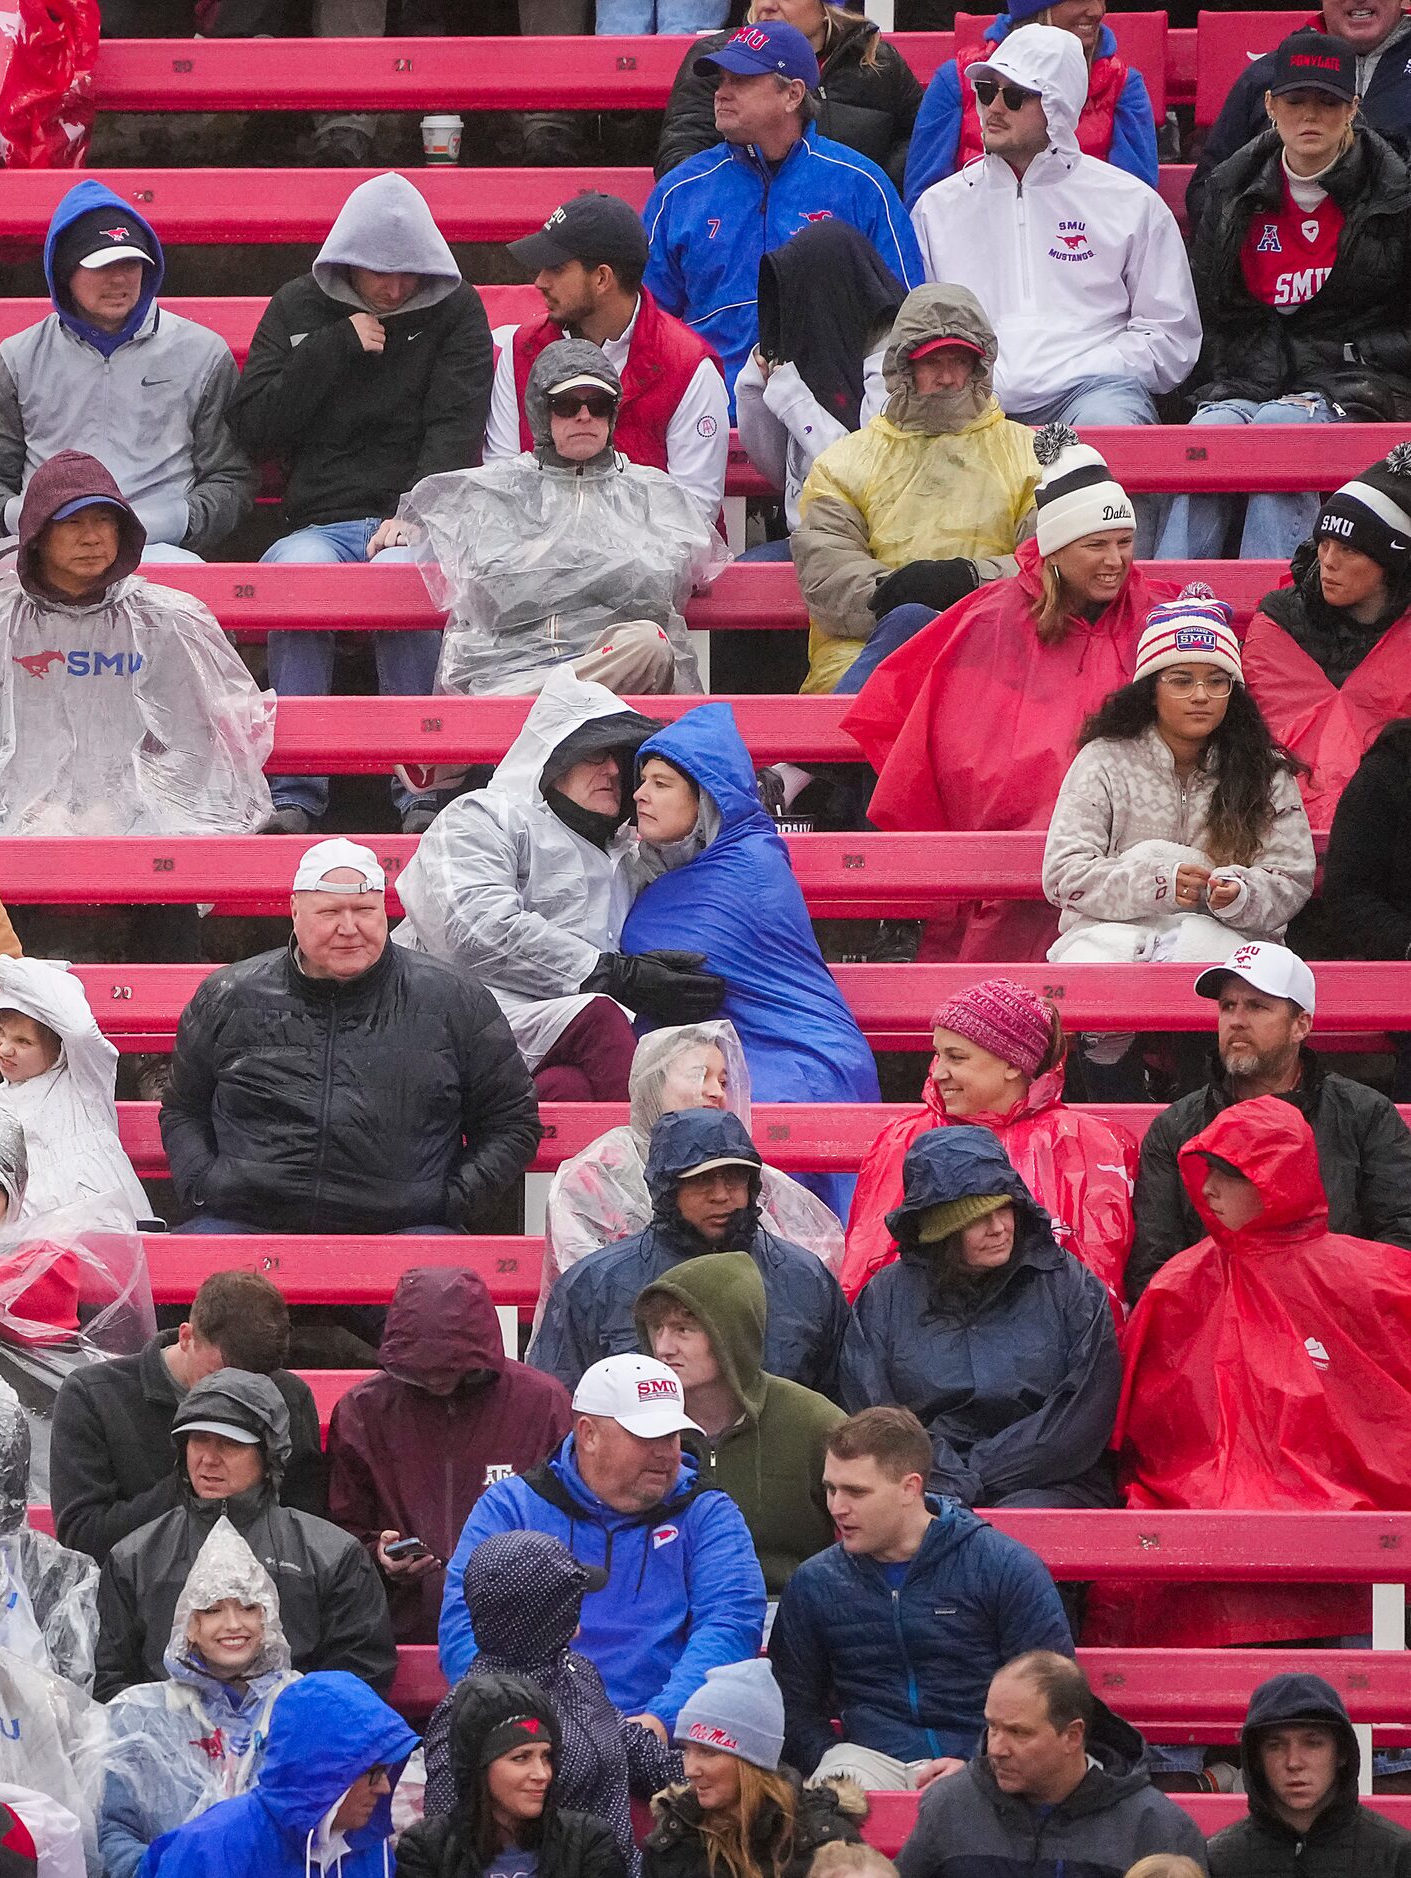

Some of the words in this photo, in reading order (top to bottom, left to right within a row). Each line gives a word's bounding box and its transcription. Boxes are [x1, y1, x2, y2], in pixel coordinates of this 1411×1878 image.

[617, 58, 636, 70] 22
[707, 219, 720, 239] 7
[1058, 222, 1086, 231] SMU
[1049, 248, 1092, 262] MUSTANGS
[1320, 515, 1355, 537] SMU
[234, 585, 254, 597] 20
[1180, 635, 1213, 645] SMU
[153, 858, 174, 871] 20
[382, 859, 400, 871] 21
[111, 986, 131, 999] 20
[1044, 985, 1065, 998] 24
[263, 1258, 279, 1270] 21
[637, 1381, 677, 1395] SMU
[689, 1722, 708, 1740] Ole
[707, 1727, 738, 1749] Miss
